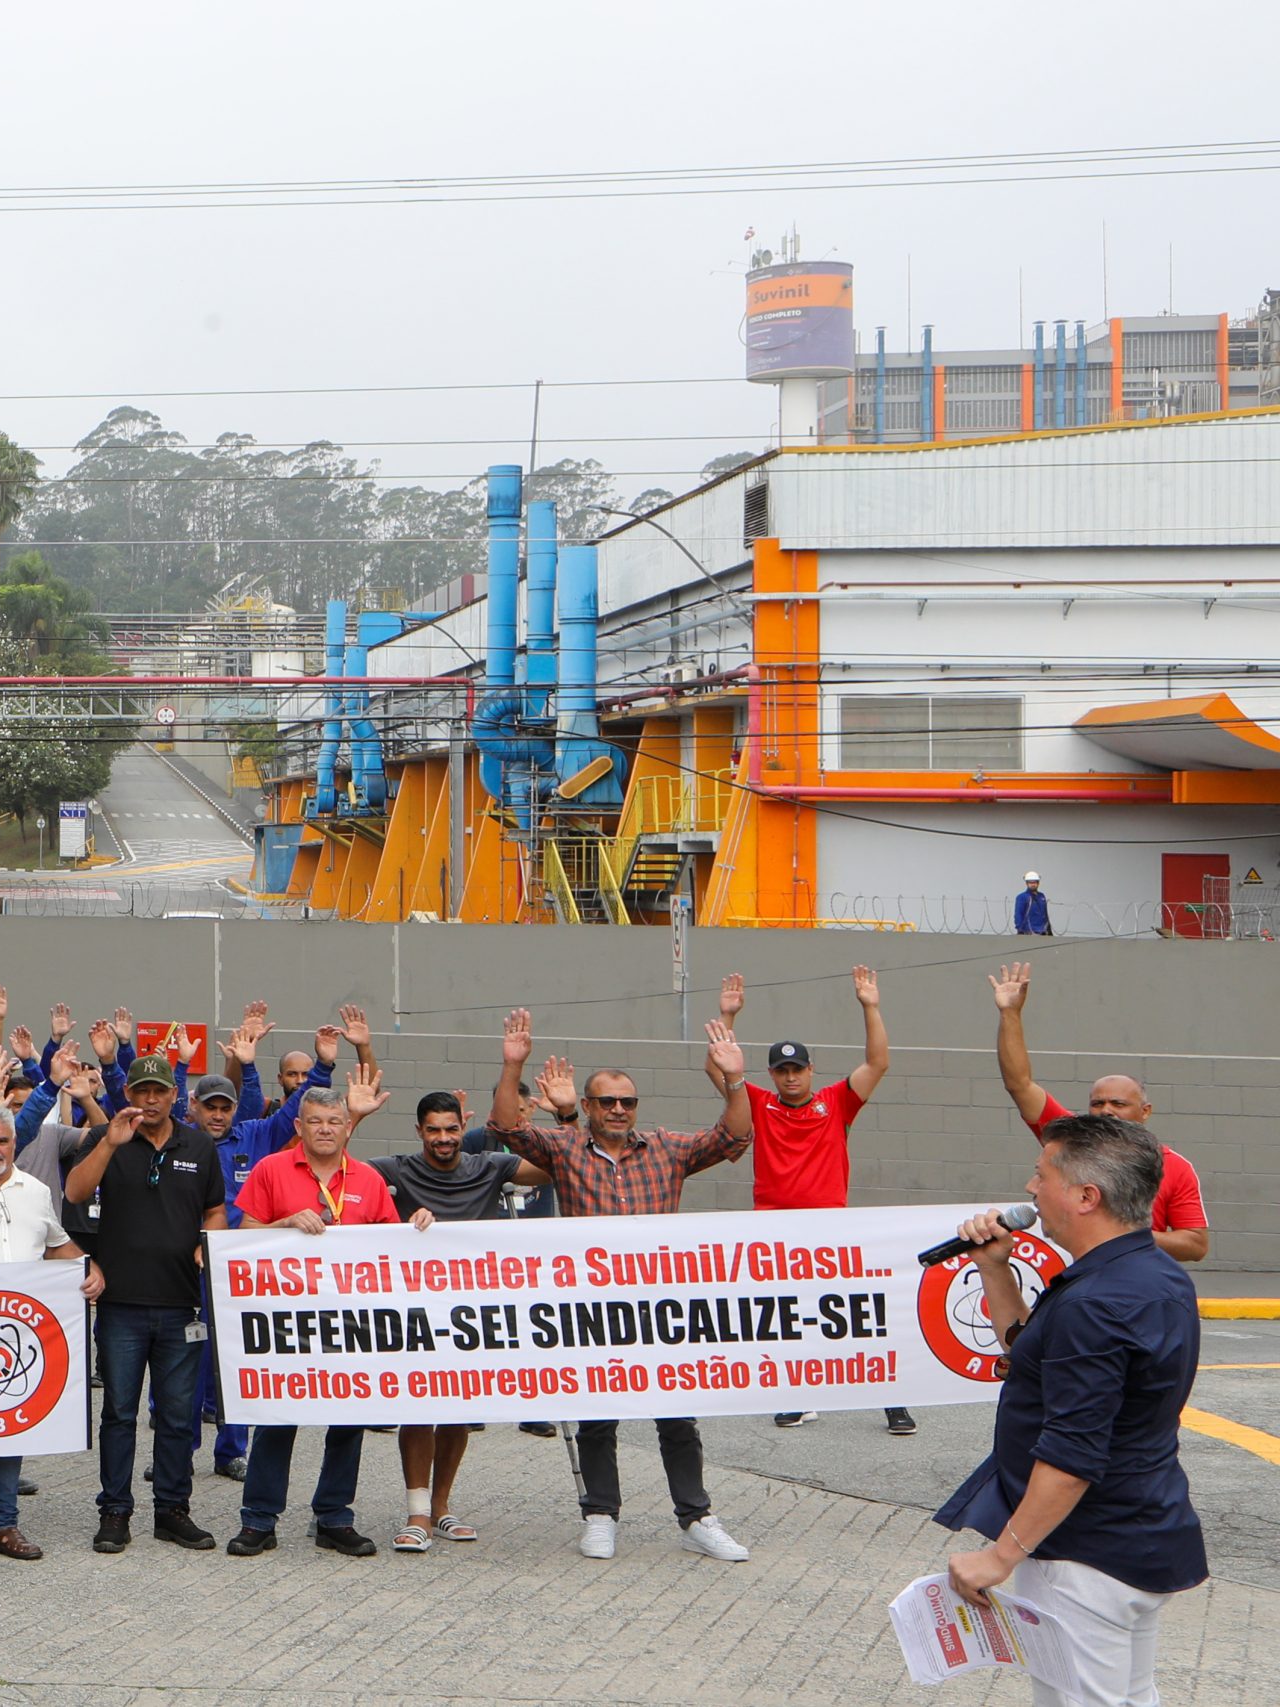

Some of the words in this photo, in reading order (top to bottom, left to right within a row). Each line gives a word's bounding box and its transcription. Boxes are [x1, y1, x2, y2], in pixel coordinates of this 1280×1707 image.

[754, 284, 810, 304] Suvinil
[228, 1257, 323, 1297] BASF
[332, 1255, 393, 1294] vai
[400, 1251, 542, 1292] vender
[552, 1255, 577, 1288] a
[585, 1241, 893, 1287] Suvinil/Glasu...
[241, 1304, 520, 1355] DEFENDA-SE!
[529, 1293, 887, 1349] SINDICALIZE-SE!
[239, 1367, 372, 1400] Direitos
[380, 1372, 400, 1398] e
[408, 1367, 579, 1401] empregos
[587, 1359, 649, 1393] não
[657, 1355, 751, 1392] estão
[759, 1354, 779, 1388] à
[786, 1350, 897, 1386] venda!
